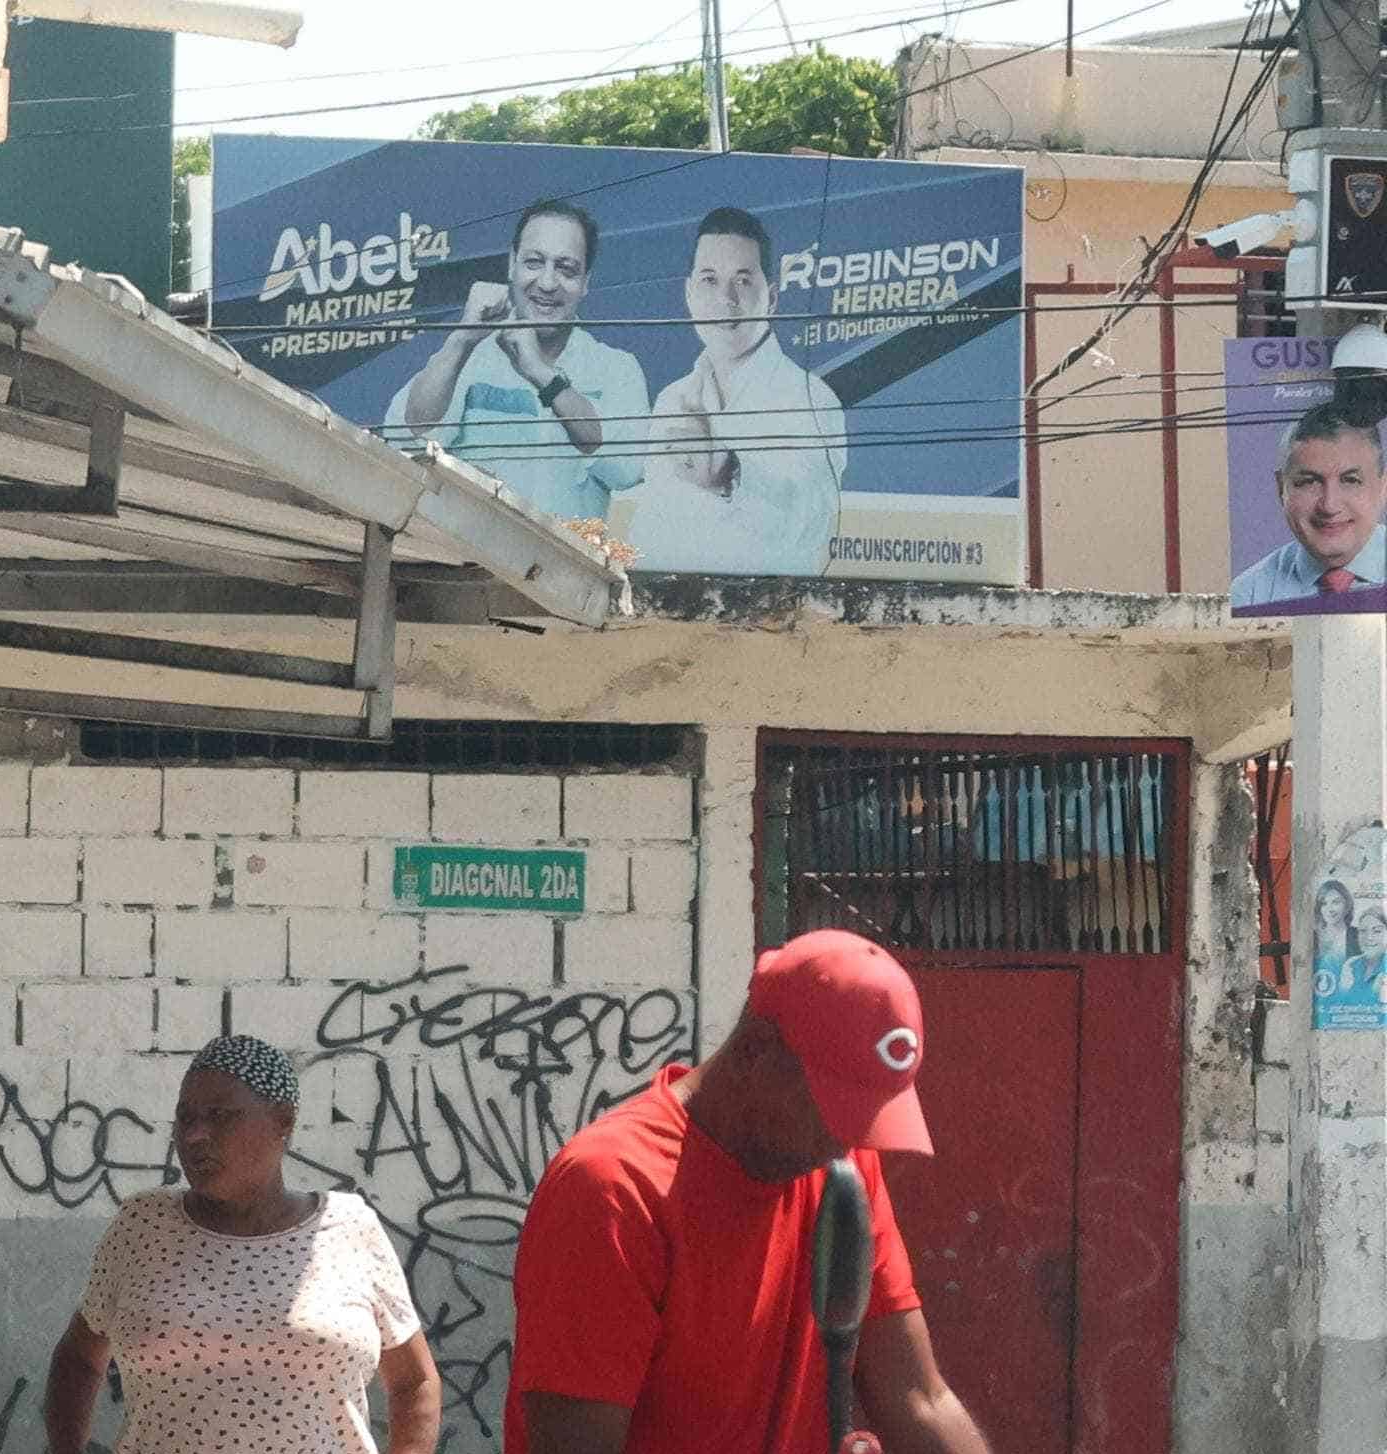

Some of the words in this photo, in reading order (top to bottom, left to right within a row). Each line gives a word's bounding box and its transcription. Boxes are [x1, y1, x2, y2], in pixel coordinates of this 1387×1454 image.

[259, 212, 419, 301] Abel
[779, 238, 999, 291] ROBINSON
[286, 288, 415, 327] MARTINEZ
[831, 275, 958, 315] HERRERA
[271, 318, 417, 358] PRESIDENTE
[965, 542, 983, 565] #3
[431, 862, 534, 898] DIAGONAL
[539, 862, 579, 899] 2DA
[876, 1027, 917, 1070] C
